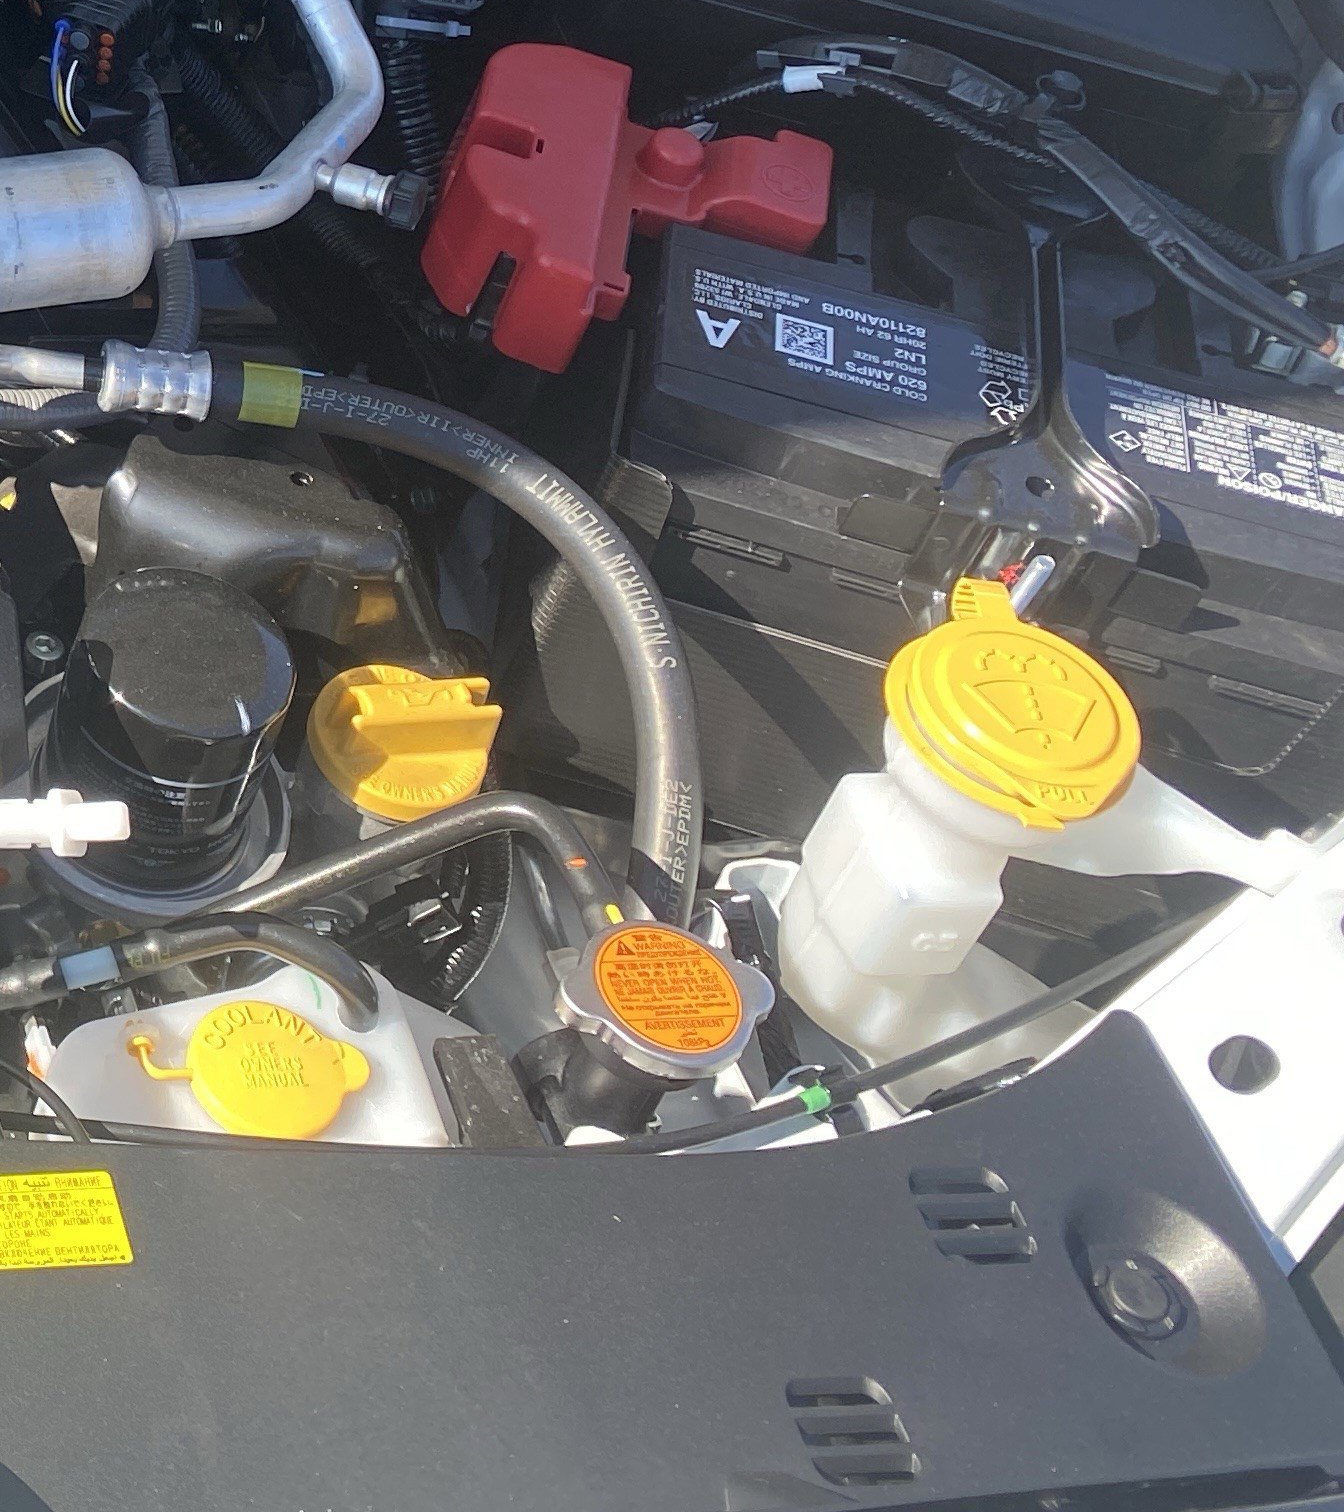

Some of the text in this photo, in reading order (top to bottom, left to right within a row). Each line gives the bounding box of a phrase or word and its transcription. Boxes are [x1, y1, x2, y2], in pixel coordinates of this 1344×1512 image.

[711, 279, 734, 291] WITH
[775, 296, 800, 309] MADE
[791, 293, 811, 304] AND
[821, 302, 927, 338] 82110AN00B
[695, 308, 741, 348] A
[876, 330, 892, 341] 62
[893, 334, 927, 350] 20HR
[852, 349, 927, 376] GROUP SIZE
[893, 347, 927, 365] LN2
[787, 357, 928, 402] COLD CRANKING AMPS
[844, 361, 928, 391] 620 AMPS
[525, 473, 616, 553] HYLAMMIT
[1035, 783, 1095, 806] PULL
[632, 940, 686, 951] WARNING
[610, 979, 639, 988] NEVER
[642, 978, 667, 987] OPEN
[670, 977, 698, 986] WHEN
[204, 1005, 323, 1050] COOLANT
[645, 1018, 726, 1030] AVERTISSEMENT
[244, 1041, 276, 1056] SEE
[244, 1072, 310, 1089] MANUAL
[54, 1175, 101, 1188] ВНИМАНИЕ
[4, 1210, 33, 1220] STARTS
[63, 1215, 114, 1227] AUTOMATIQUE
[4, 1230, 20, 1239] LES
